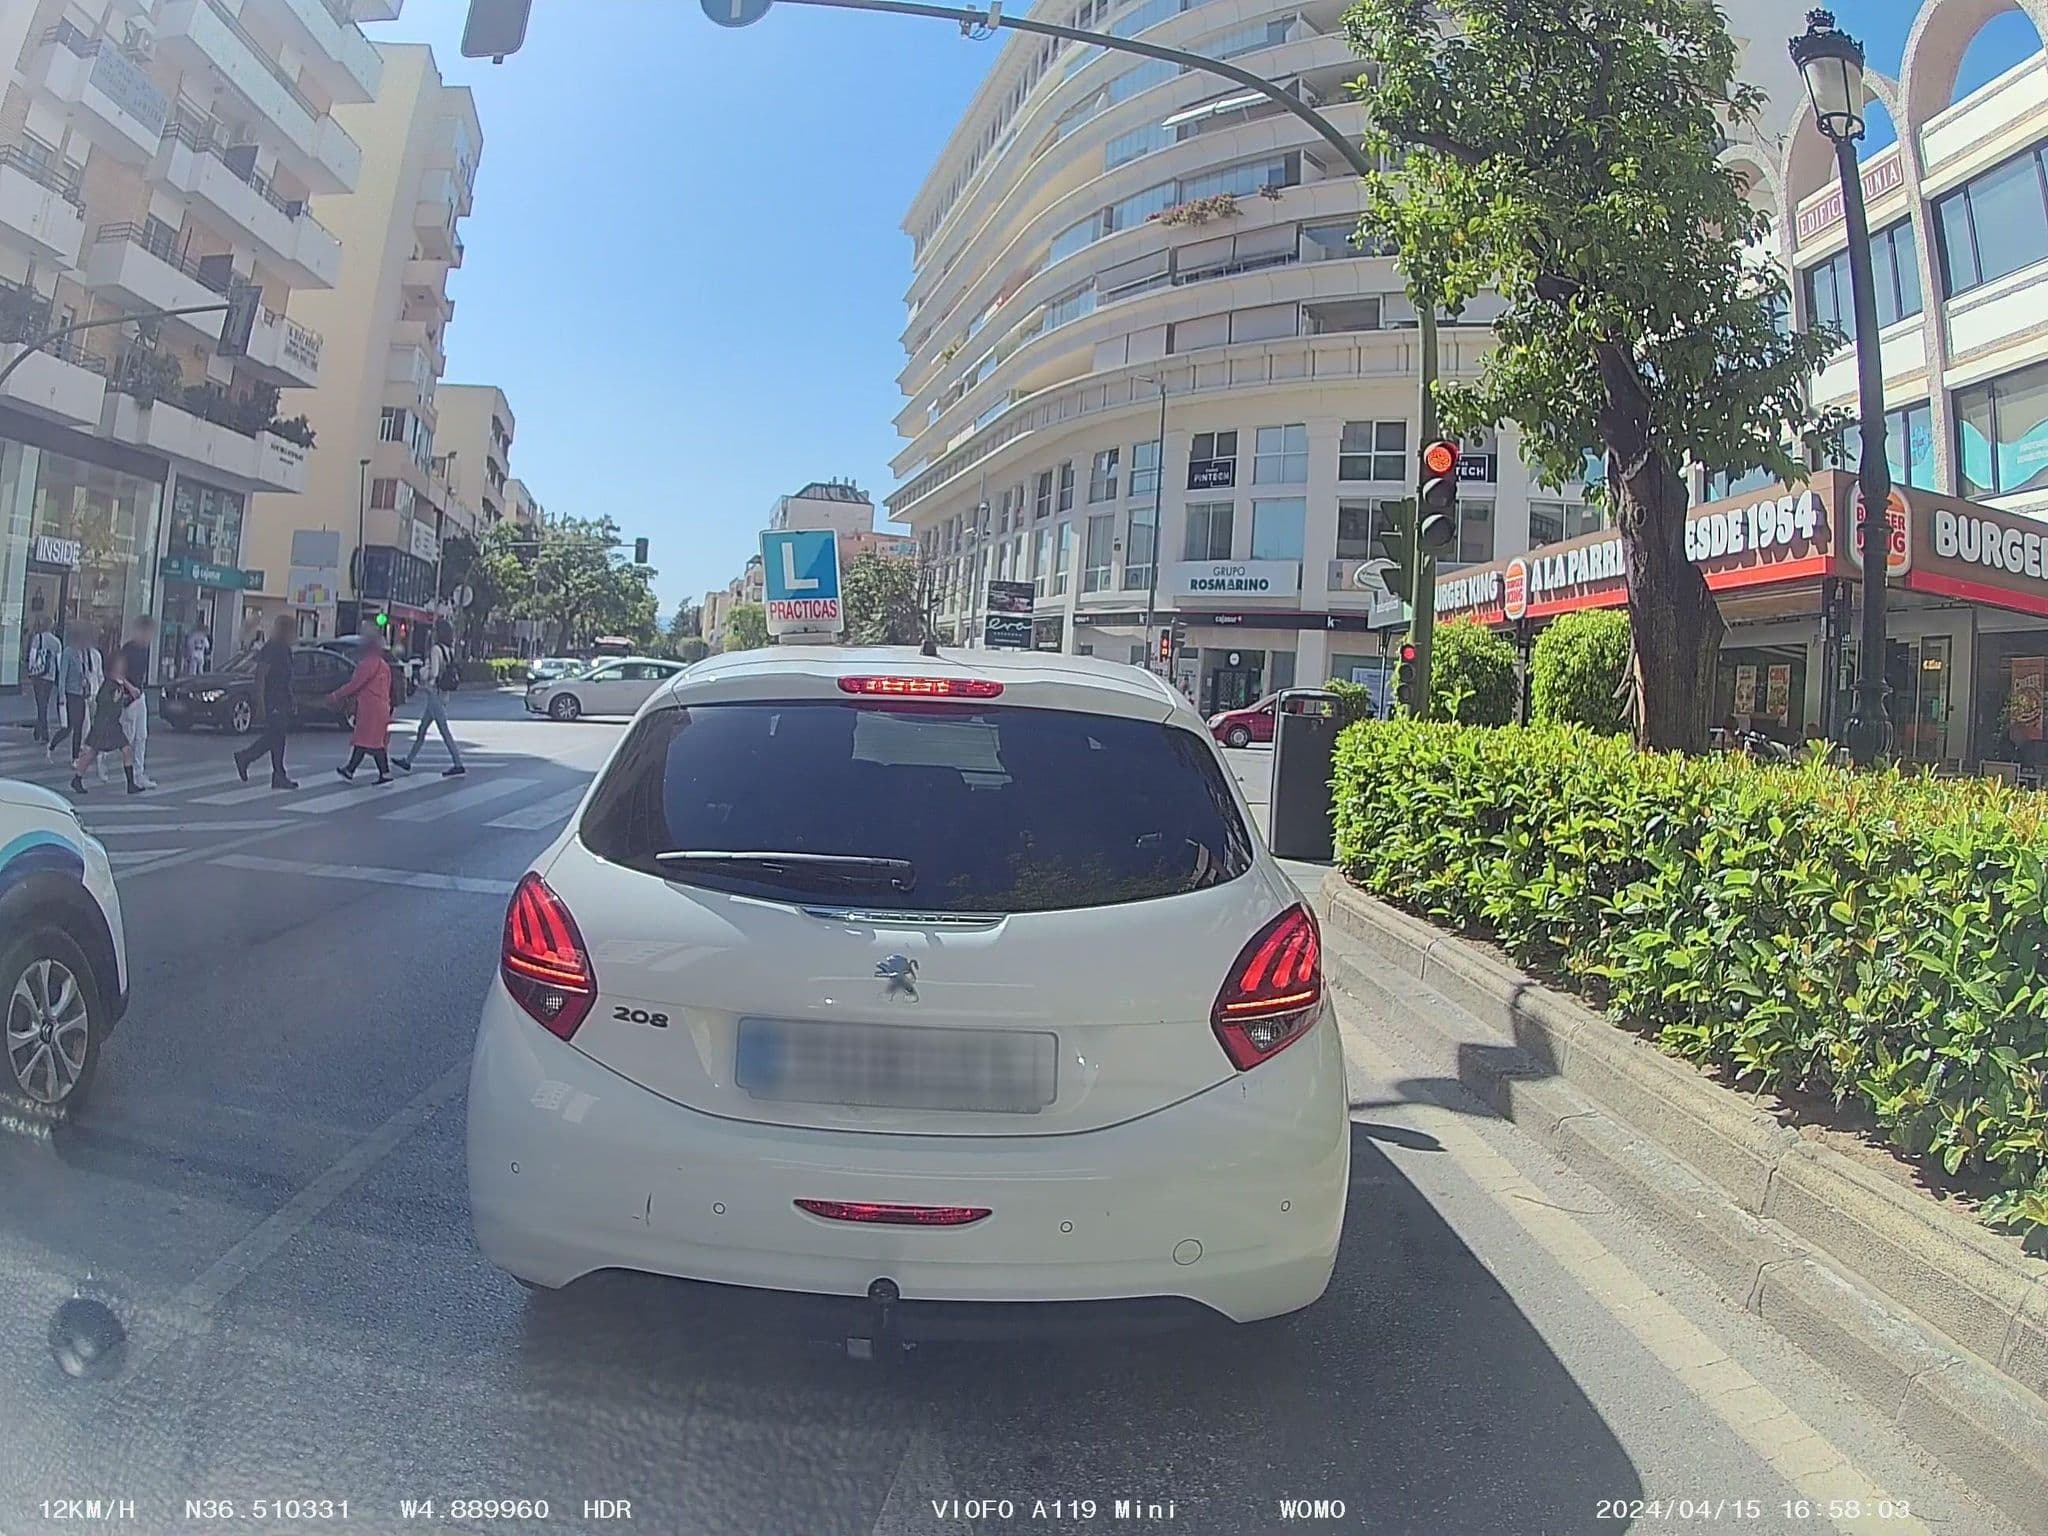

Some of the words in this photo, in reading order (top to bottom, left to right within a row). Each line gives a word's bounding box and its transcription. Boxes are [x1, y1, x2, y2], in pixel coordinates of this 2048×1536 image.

[1800, 193, 1846, 236] EDIFICI
[1861, 161, 1899, 199] UNIA
[1456, 466, 1484, 477] TECH
[1568, 538, 1626, 585] PARRI
[1685, 508, 1744, 561] ESDE
[1747, 489, 1817, 550] 1954
[39, 537, 81, 564] INSIDE
[781, 542, 819, 589] L
[1213, 566, 1246, 577] GRUPO
[1190, 578, 1270, 591] ROSMARINO
[1434, 578, 1468, 612] URGER
[1469, 570, 1499, 606] KING
[770, 599, 838, 620] PRACTICAS
[612, 1006, 669, 1029] 208
